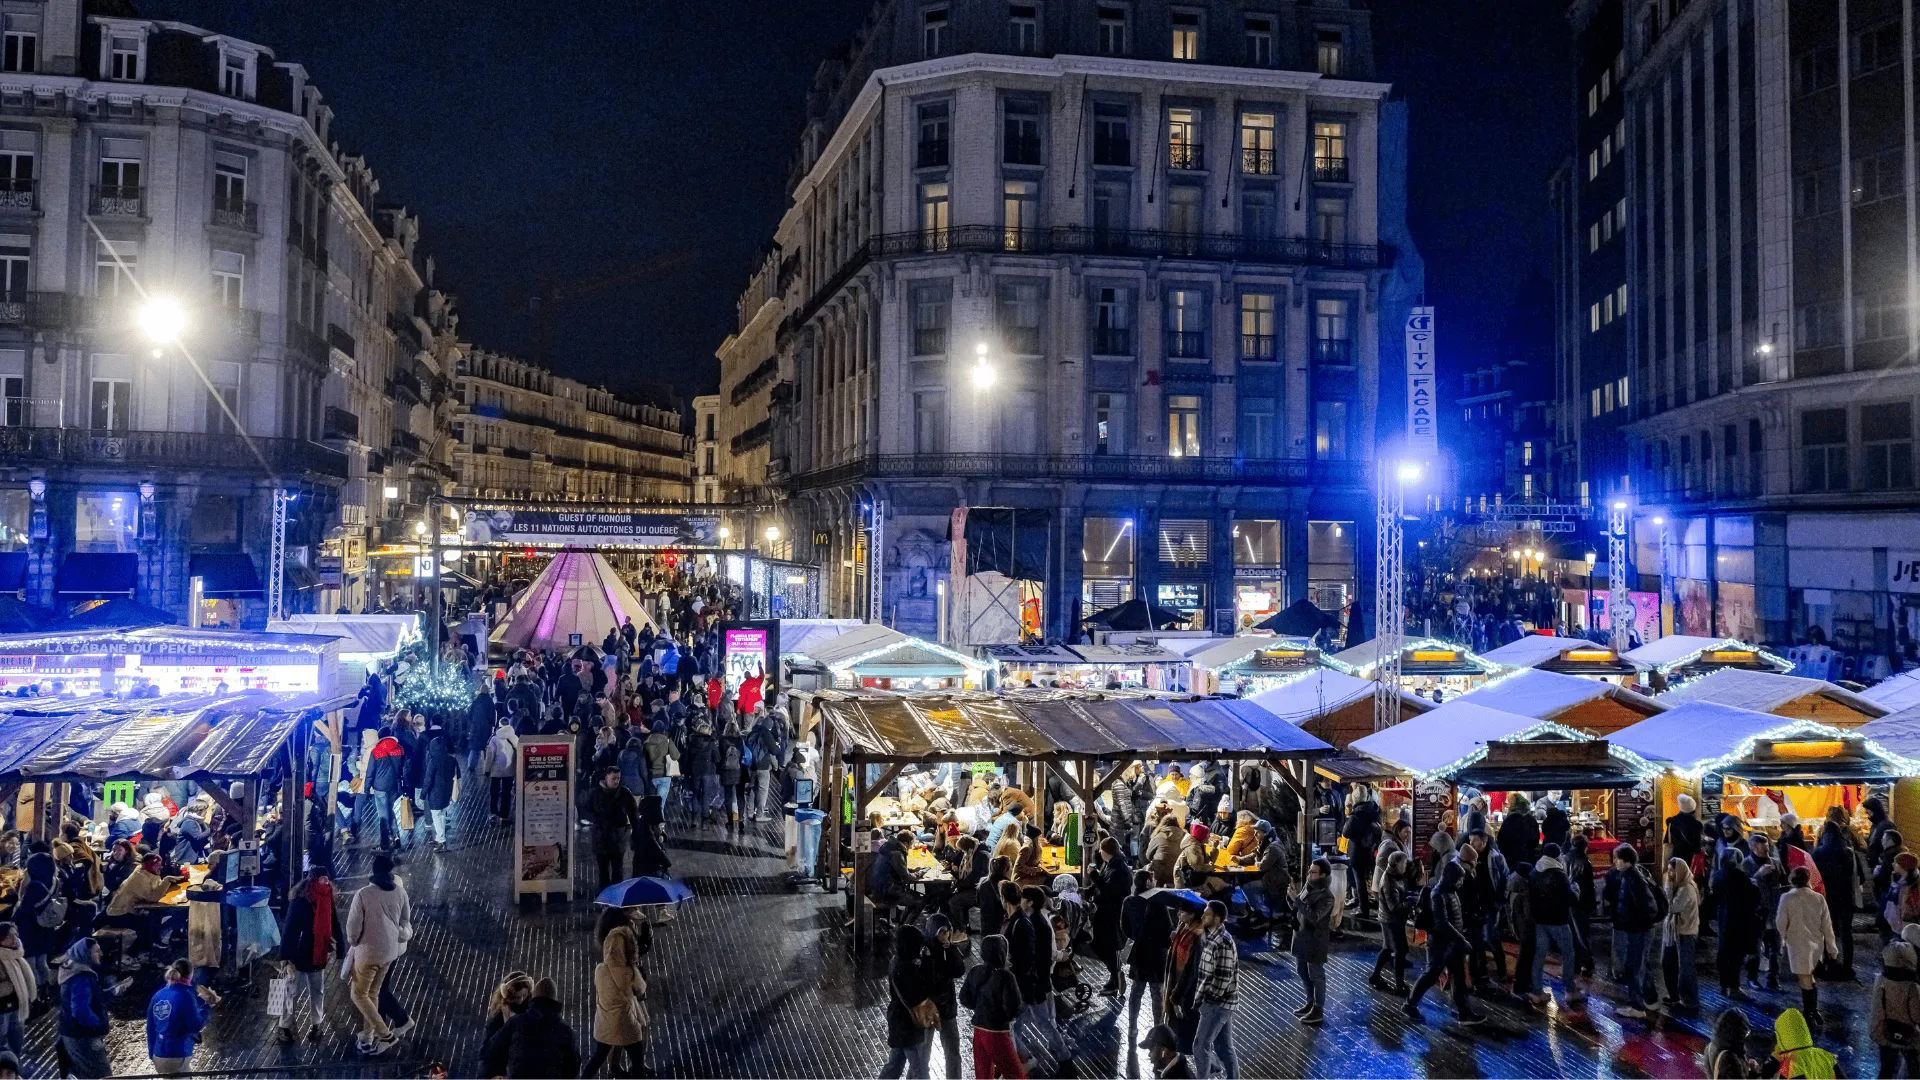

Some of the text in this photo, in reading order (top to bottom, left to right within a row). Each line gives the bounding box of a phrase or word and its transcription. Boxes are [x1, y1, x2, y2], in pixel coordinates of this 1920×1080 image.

[1412, 333, 1431, 435] CITY FACADE
[558, 513, 632, 523] GUEST OF HONOUR
[513, 523, 679, 535] LES 11 NATIONS AUTOCHTONES DU QUÉBEC
[1235, 568, 1287, 576] McDonald's
[45, 643, 65, 653] LA
[70, 643, 127, 654] CABANE
[133, 643, 152, 654] DU
